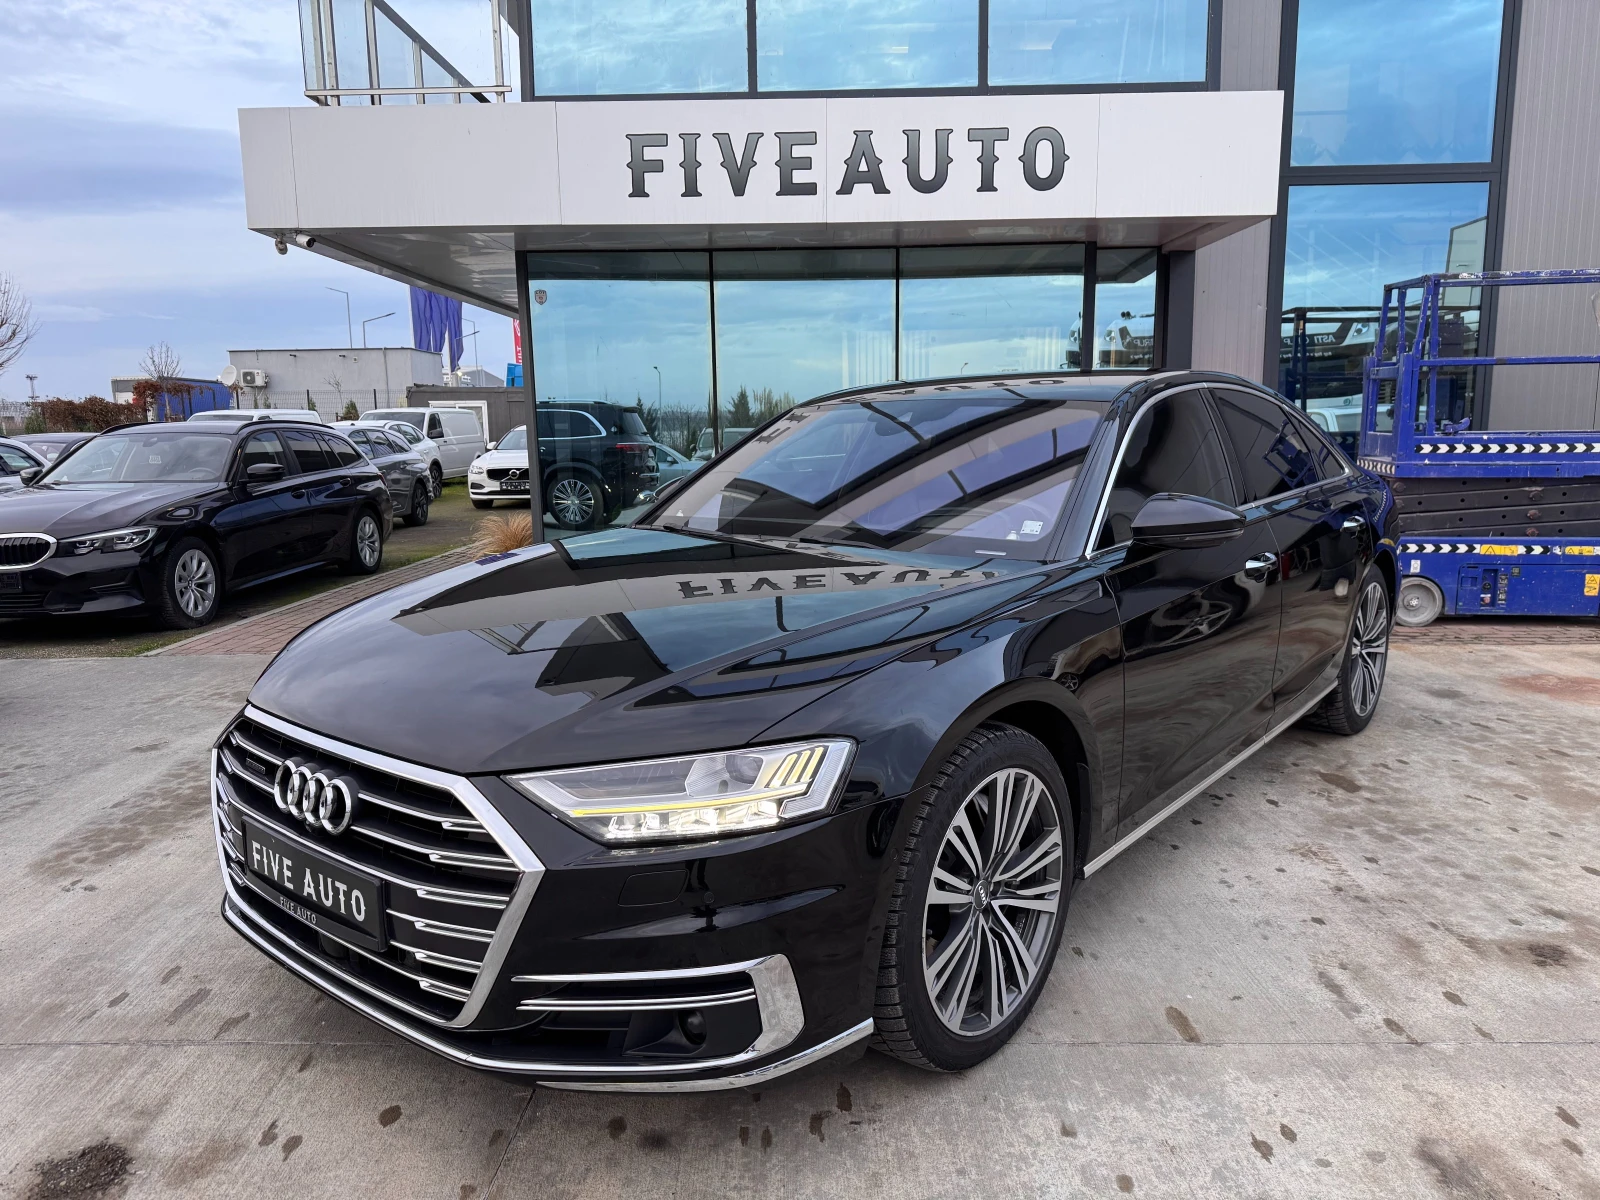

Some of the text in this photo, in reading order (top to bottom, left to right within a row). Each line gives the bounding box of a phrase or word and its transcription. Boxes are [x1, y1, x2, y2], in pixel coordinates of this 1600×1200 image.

[625, 126, 1070, 198] FIVE AUTO
[252, 840, 366, 922] FIVE AUTO
[280, 896, 317, 925] FIVE AUTO
